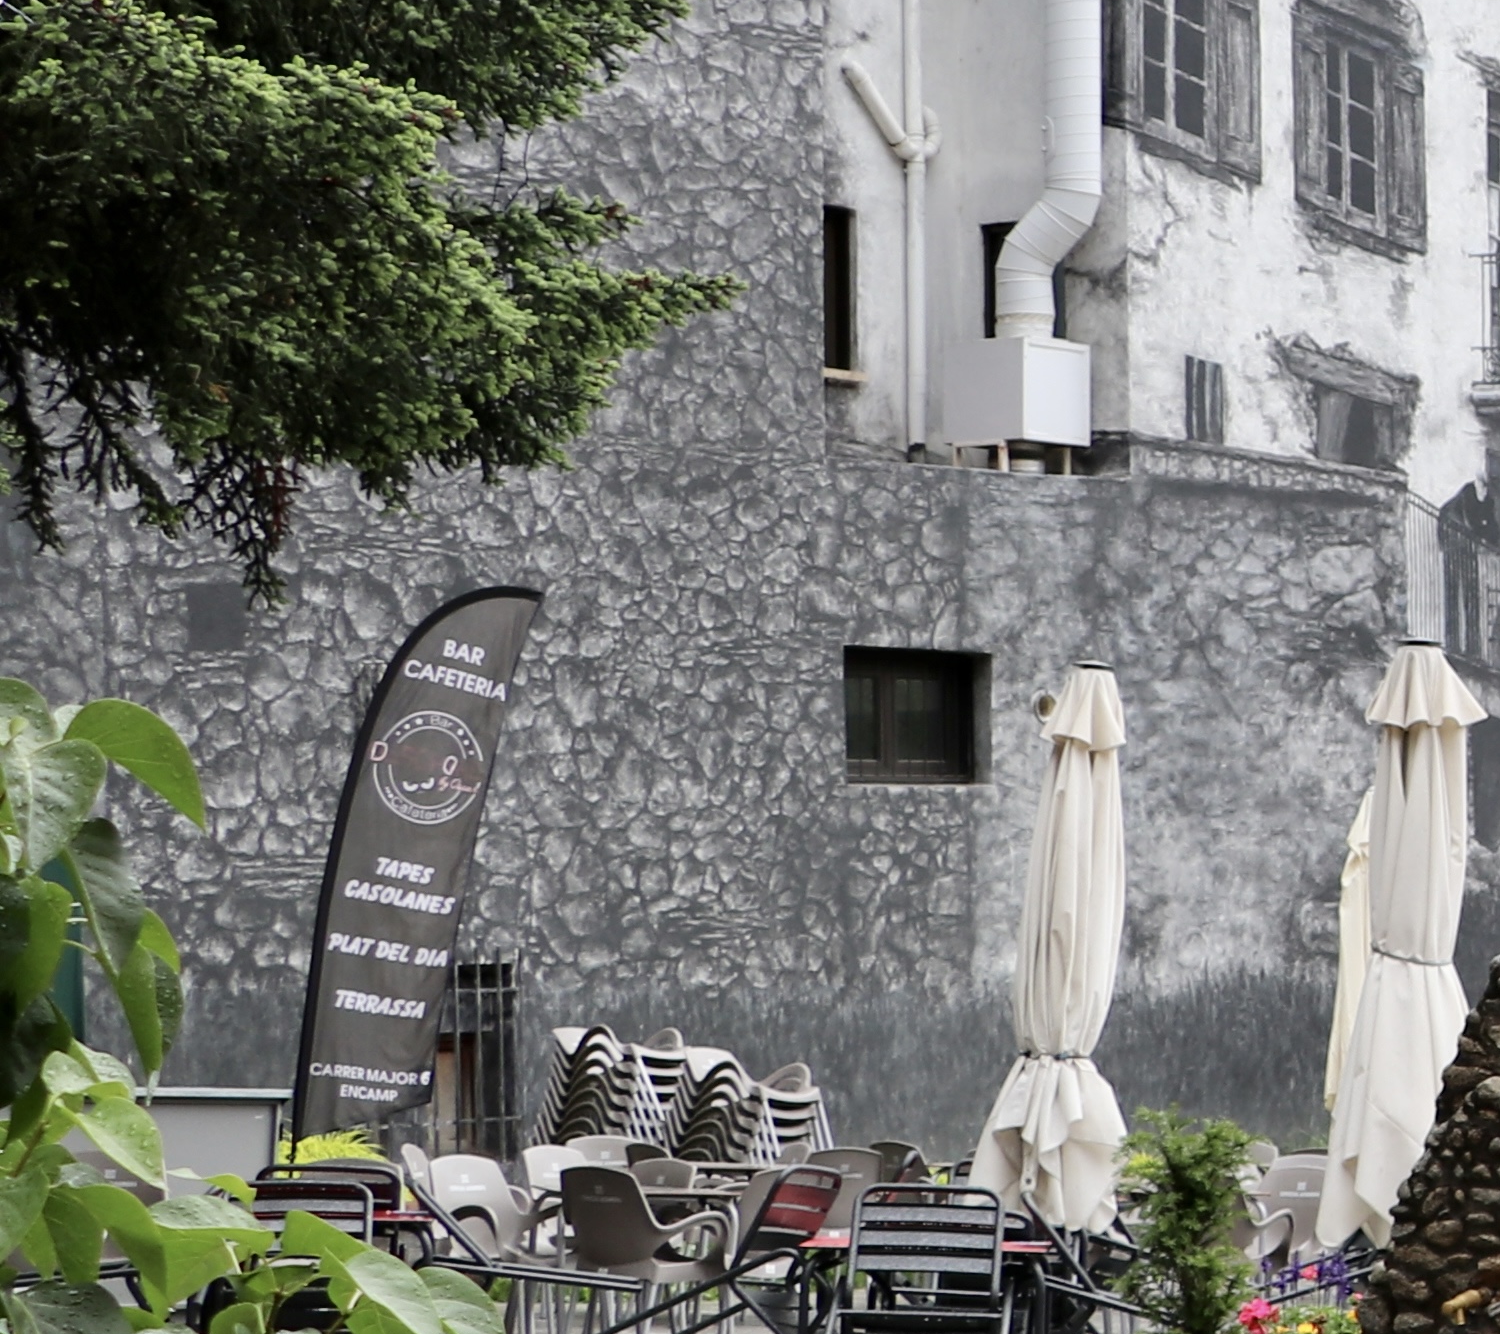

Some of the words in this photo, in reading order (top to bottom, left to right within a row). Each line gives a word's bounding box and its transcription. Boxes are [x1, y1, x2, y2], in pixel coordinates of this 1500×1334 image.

[443, 639, 485, 665] BAR
[404, 659, 506, 702] CAFETERIA
[430, 715, 453, 729] Bar
[376, 856, 435, 884] TAPES
[344, 879, 456, 915] CASOLANES
[327, 932, 376, 957] PLAT
[374, 940, 411, 963] DEL
[414, 947, 449, 968] DIA
[335, 989, 426, 1019] TERRASSA
[309, 1062, 364, 1080] CARRER
[366, 1068, 418, 1085] MAJOR
[420, 1071, 431, 1085] 6
[340, 1083, 398, 1102] ENCAMP
